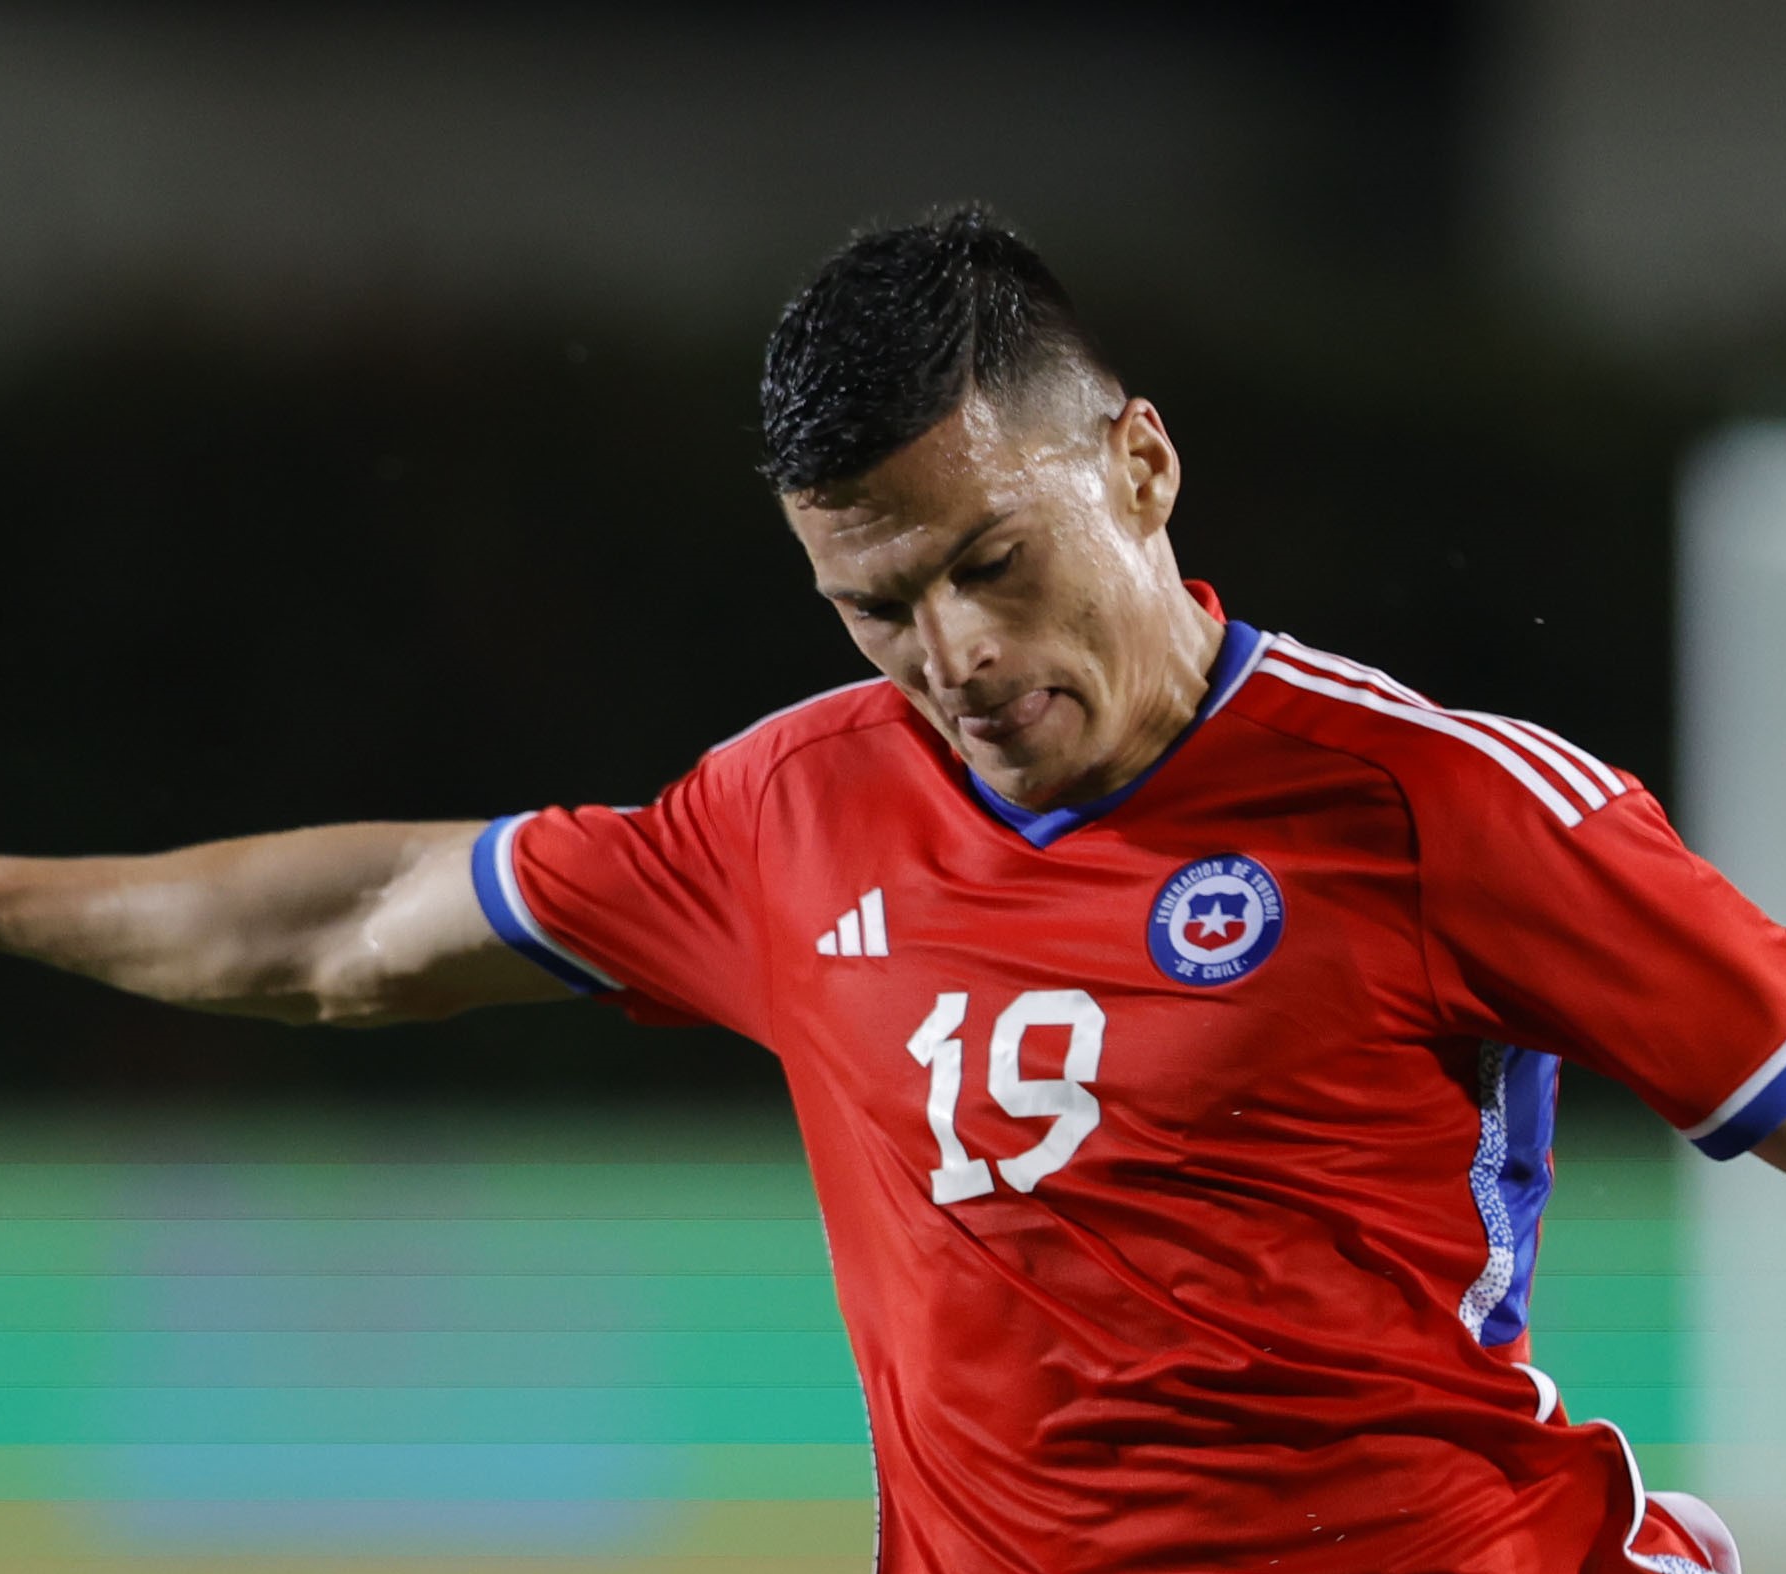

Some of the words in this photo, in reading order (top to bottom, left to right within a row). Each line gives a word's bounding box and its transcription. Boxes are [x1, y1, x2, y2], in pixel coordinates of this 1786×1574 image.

[1155, 860, 1224, 924] FEDERACION
[1231, 861, 1252, 878] DE
[1251, 874, 1280, 922] FUTBOL
[906, 990, 1106, 1205] 19
